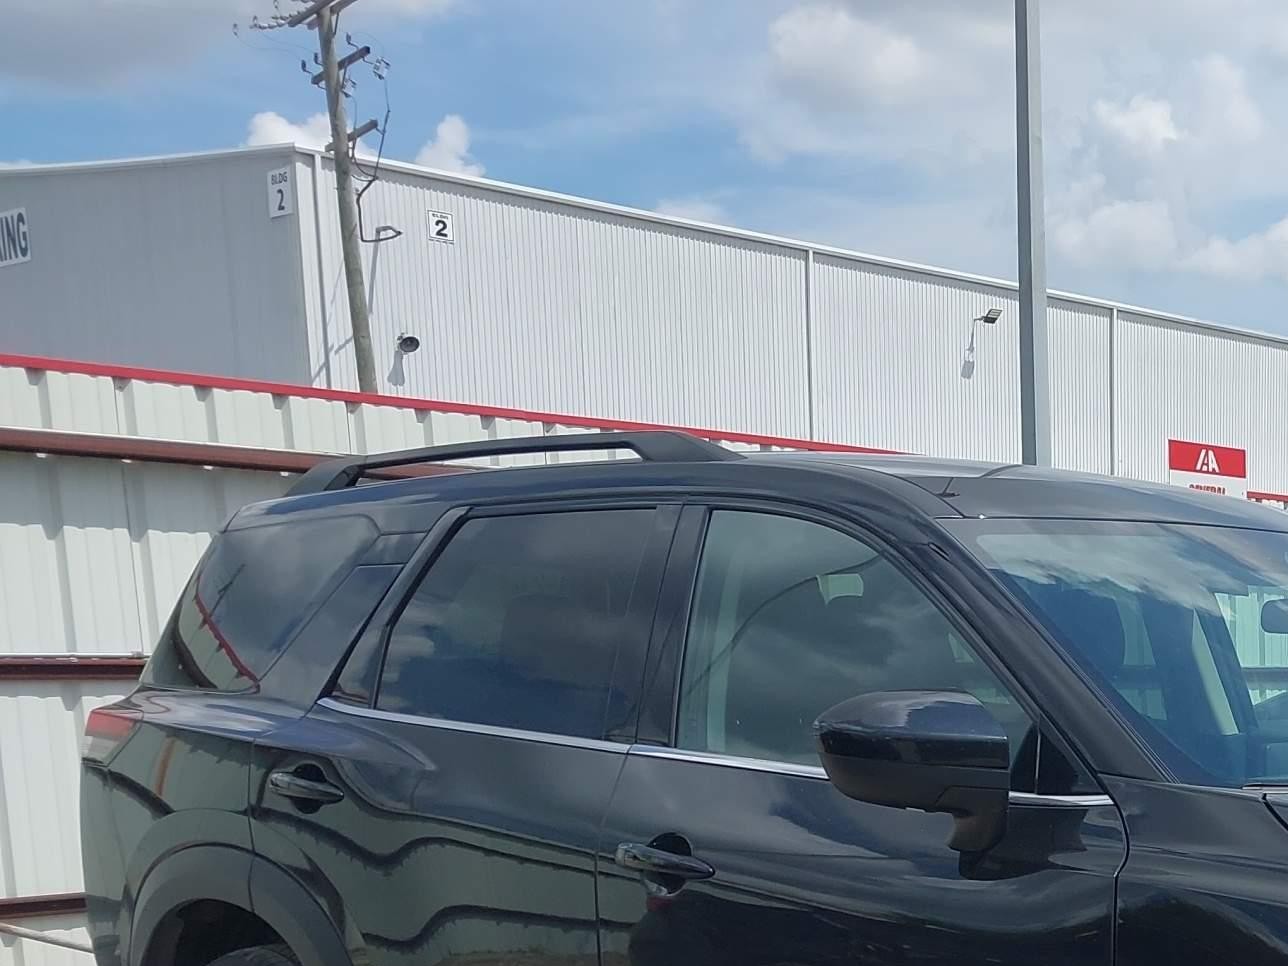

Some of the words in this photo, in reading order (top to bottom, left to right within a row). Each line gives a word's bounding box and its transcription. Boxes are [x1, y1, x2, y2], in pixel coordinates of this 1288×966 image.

[271, 171, 288, 185] BLDG
[277, 188, 285, 211] 2
[0, 212, 29, 262] ING
[435, 219, 448, 238] 2
